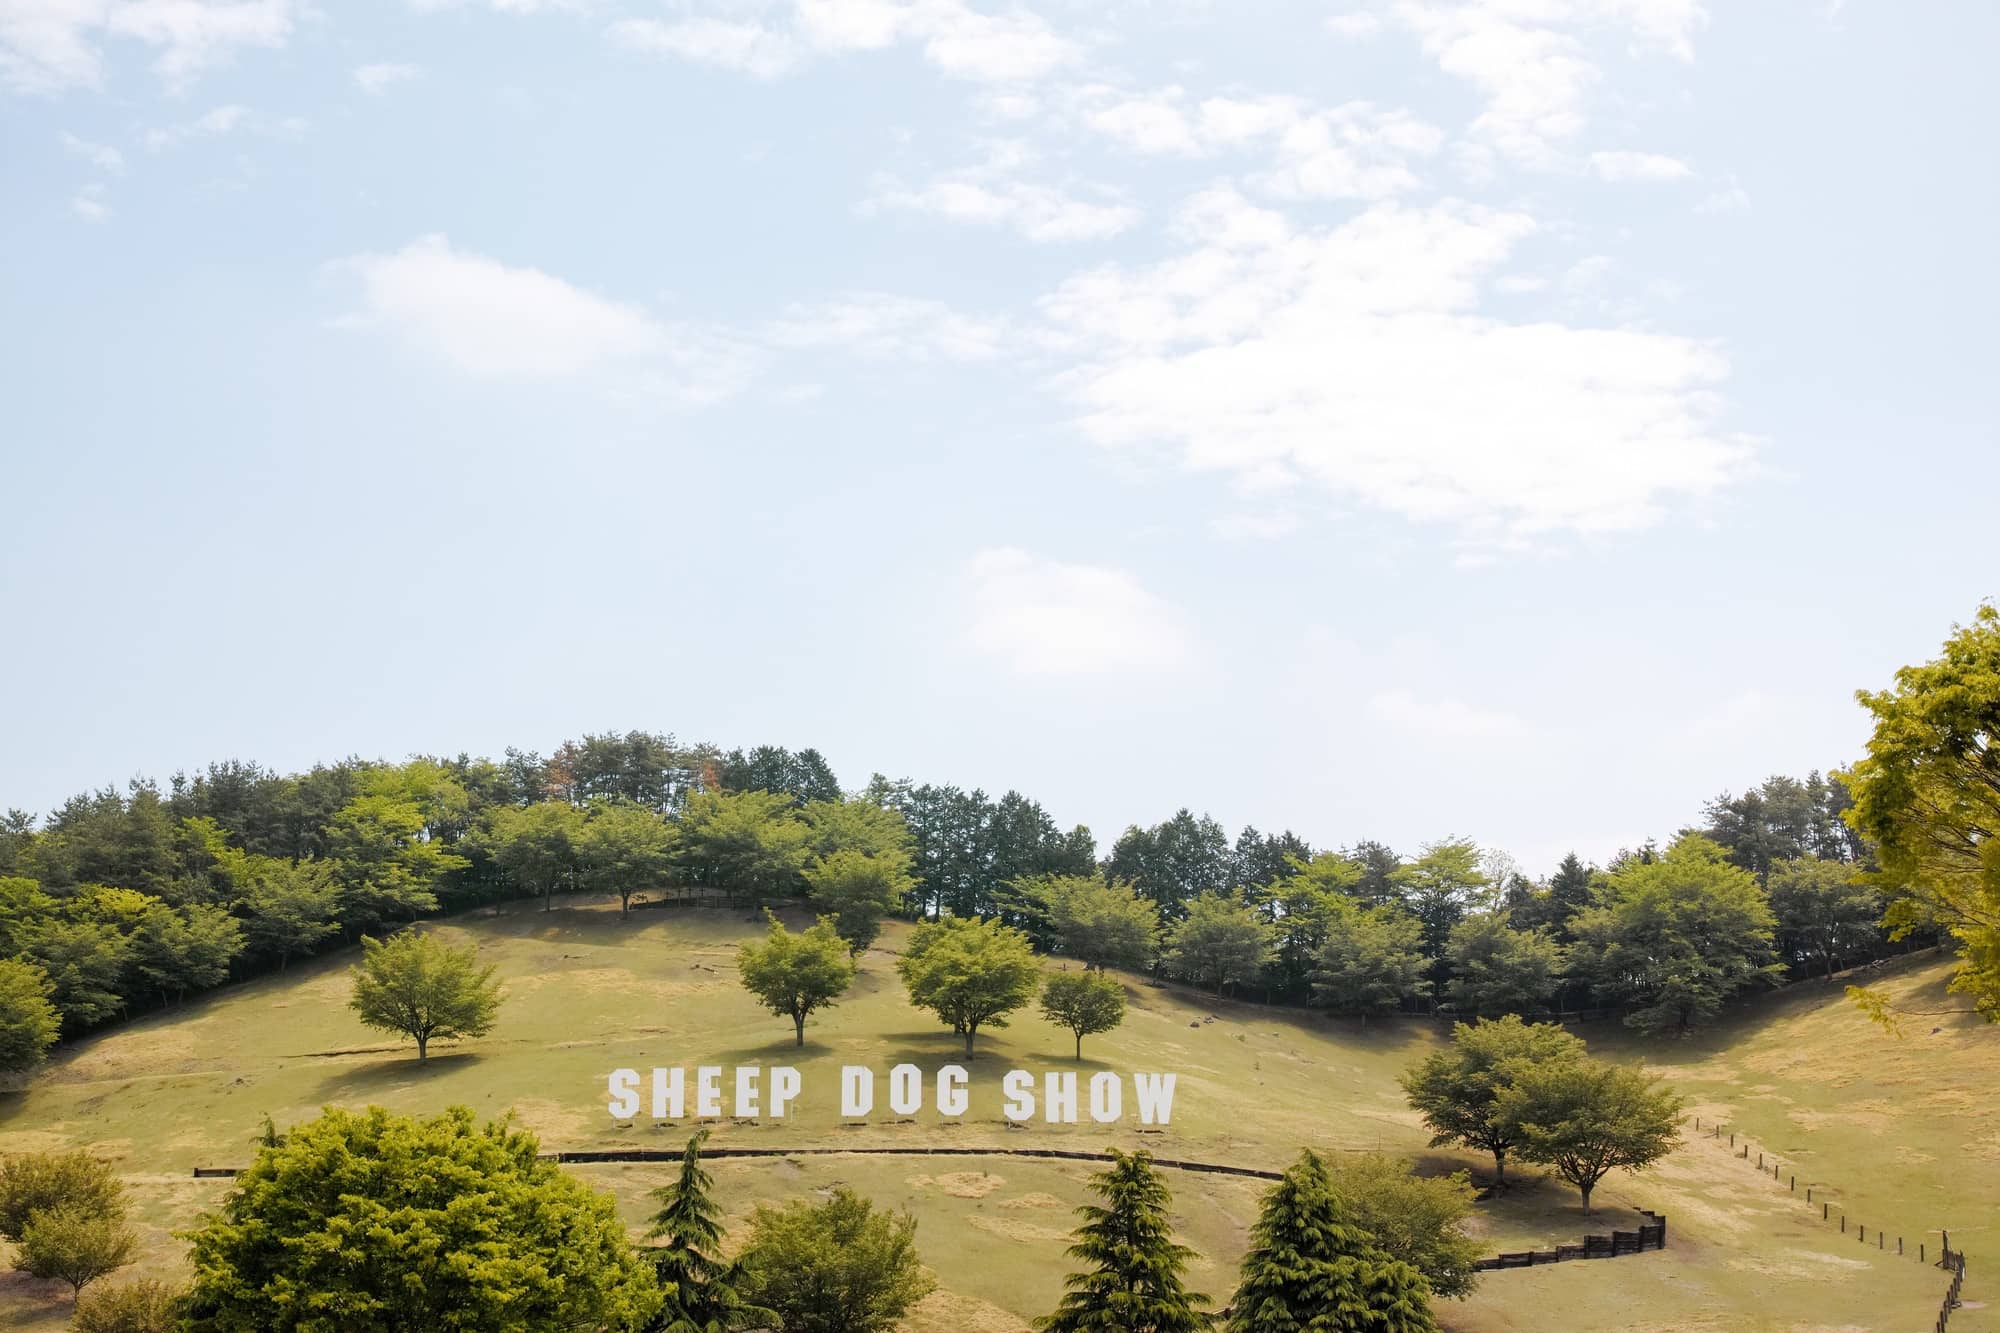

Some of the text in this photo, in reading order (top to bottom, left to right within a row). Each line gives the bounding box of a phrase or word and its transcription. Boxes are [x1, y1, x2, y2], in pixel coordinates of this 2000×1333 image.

[608, 1063, 1177, 1125] SHEEP DOG SHOW
